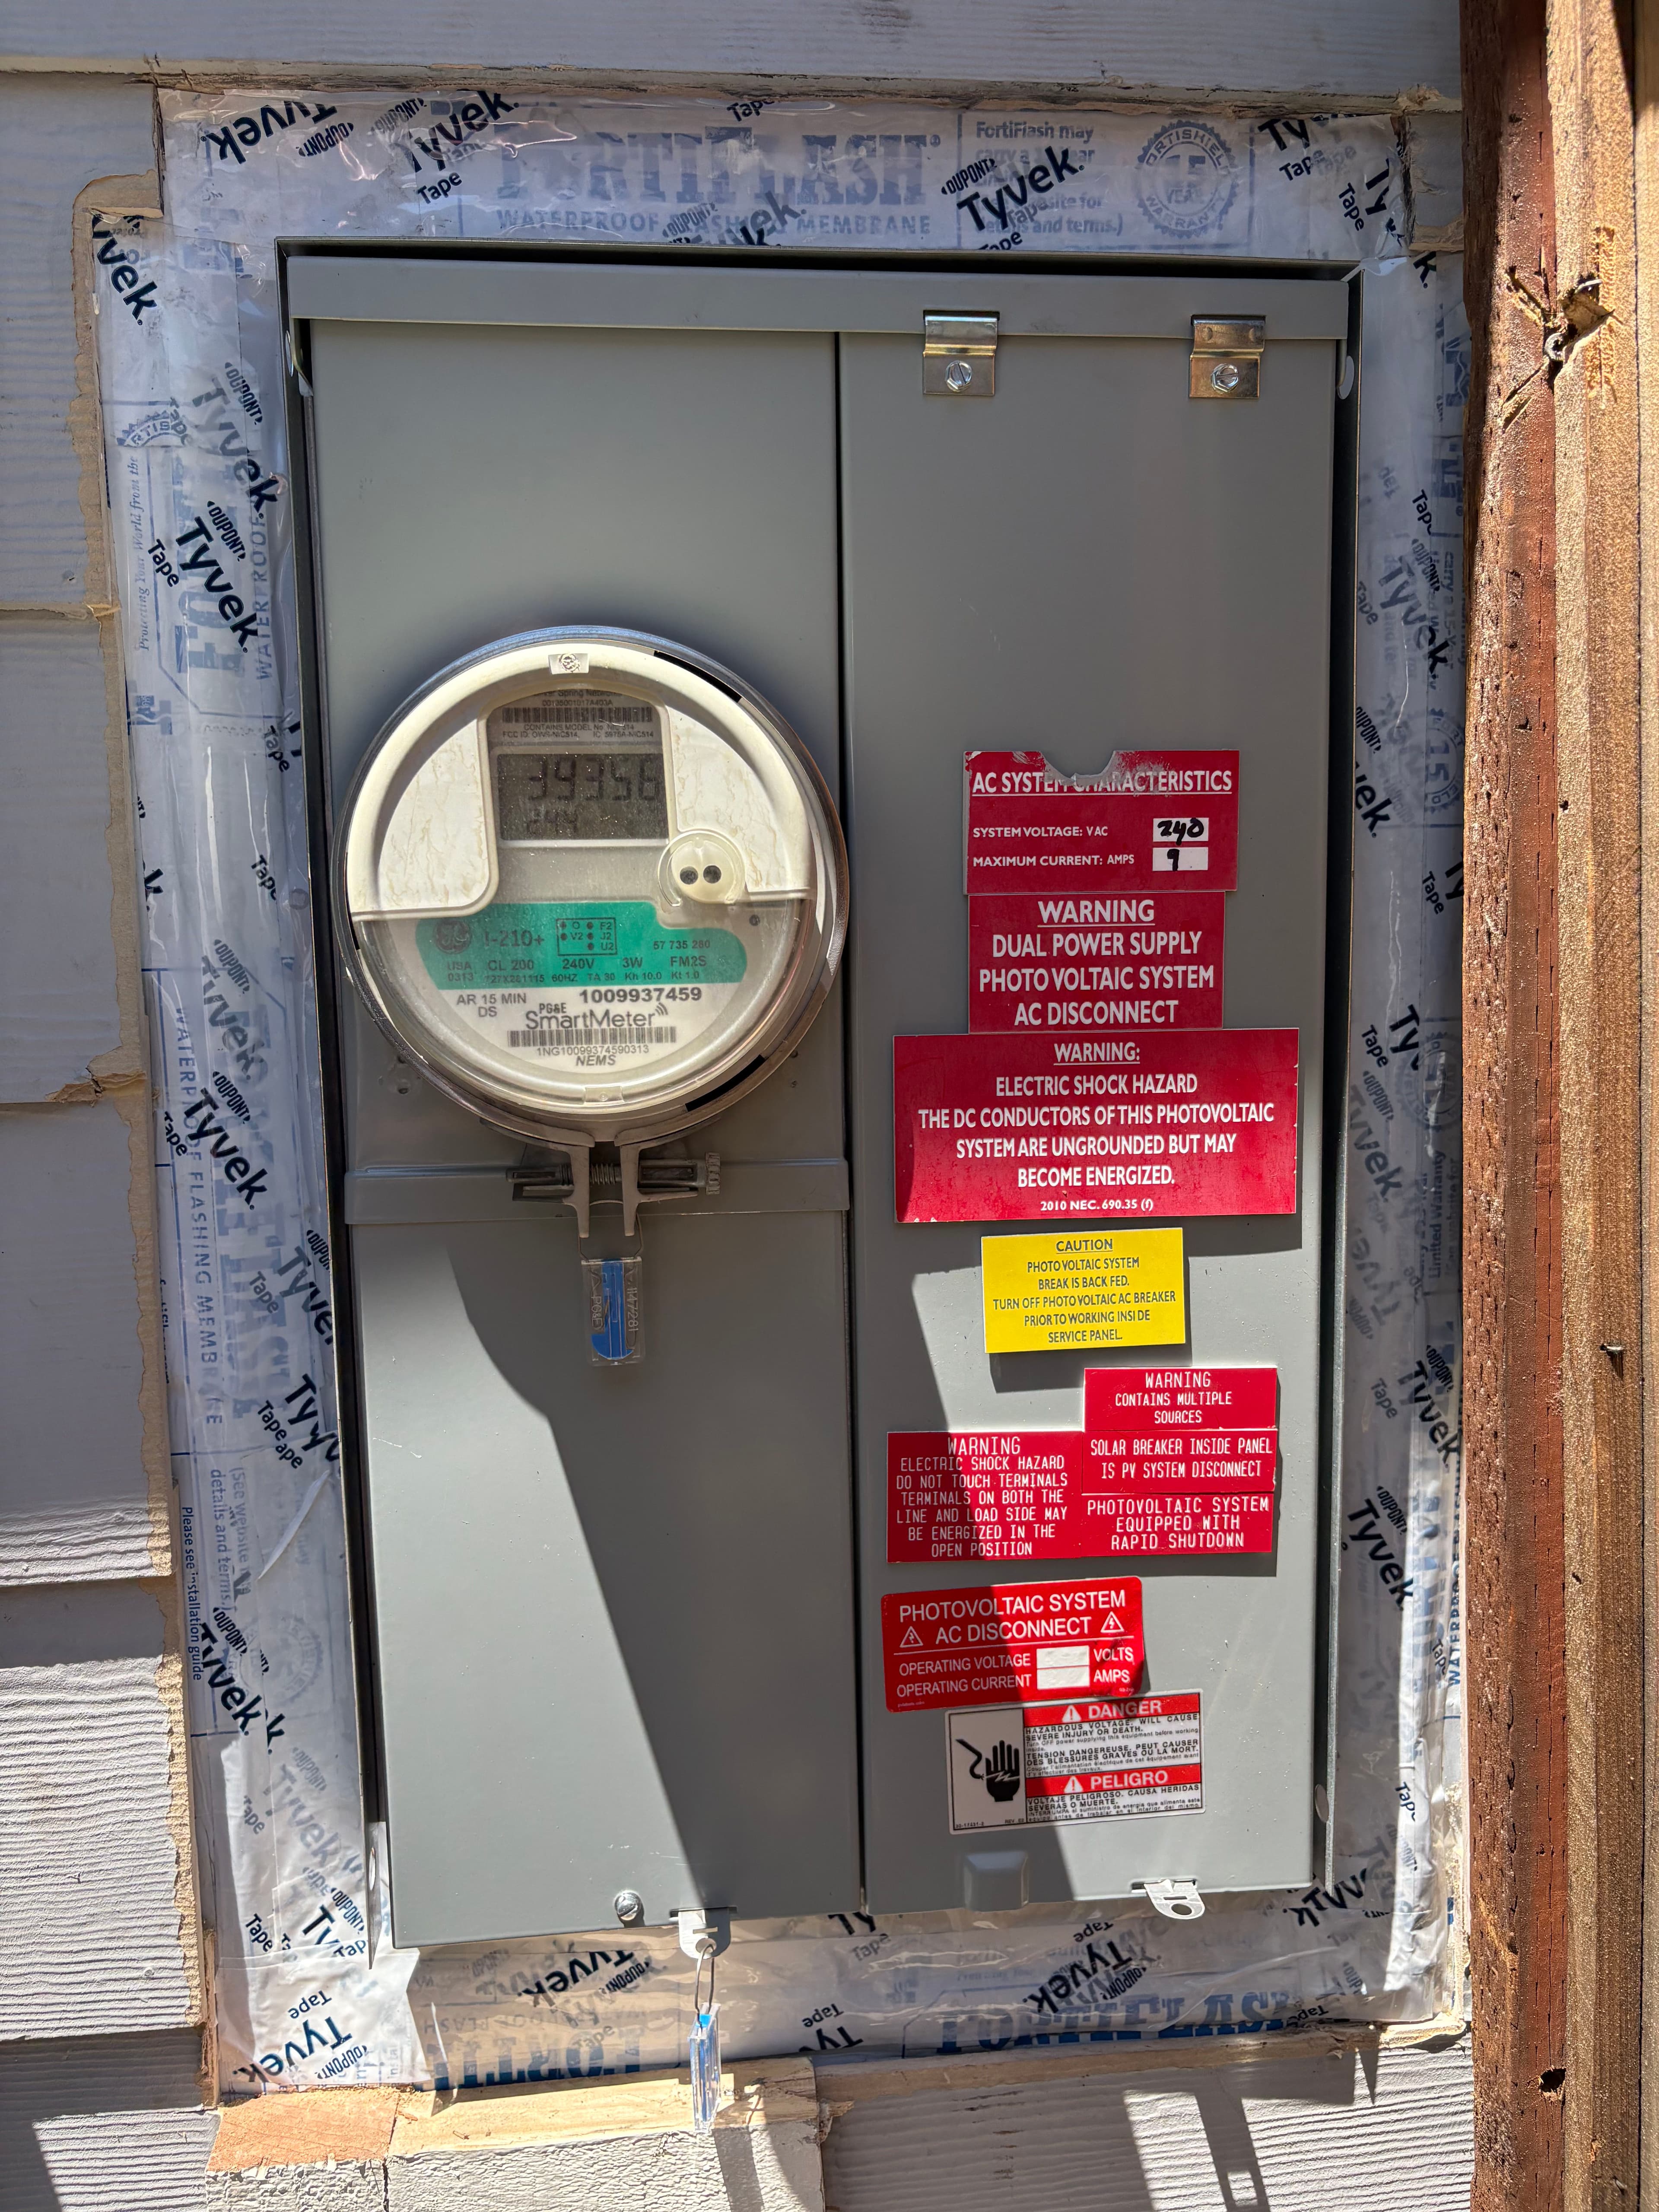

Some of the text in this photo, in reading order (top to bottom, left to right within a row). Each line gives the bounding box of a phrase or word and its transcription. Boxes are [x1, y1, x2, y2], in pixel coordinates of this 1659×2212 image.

[977, 121, 1094, 143] FortiFlash may
[417, 172, 462, 204] Tape
[1339, 183, 1364, 231] Tape
[797, 214, 930, 235] MEMBRANE
[148, 539, 179, 587] Tape
[973, 827, 1021, 837] SYSTEM
[1023, 826, 1082, 837] VOLTAGE:
[1158, 818, 1205, 845] 240
[973, 854, 1134, 867] MAXIMUM CURRENT: AMPS
[1038, 899, 1154, 923] WARNING
[669, 941, 688, 949] 735
[993, 931, 1202, 957] DUAL POWER SUPPLY
[488, 956, 706, 970] CL 200 240V 3W FM2S
[1140, 965, 1214, 989] SYSTEM
[483, 995, 496, 1004] 15
[502, 993, 526, 1003] MIN
[579, 987, 702, 1003] 1009937459
[479, 1007, 497, 1017] DS
[539, 1003, 566, 1014] PG&E
[1014, 1000, 1179, 1025] AC DISCONNECT
[526, 1010, 655, 1029] SmartMeter
[537, 1045, 649, 1056] 1NG10099374590313
[1054, 1042, 1140, 1062] WARNING:
[1361, 1024, 1389, 1067] Tape
[576, 1055, 616, 1066] NEMS
[996, 1074, 1197, 1096] ELECTRIC SHOCK HAZARD
[918, 1103, 1274, 1128] THE DC CONDUCTORS OF THIS PHOTOVOLTAIC
[164, 1111, 188, 1157] Tape
[957, 1134, 1236, 1158] SYSTEM ARE UNGROUNDED BUT MAY
[1018, 1165, 1175, 1187] BECOME ENERGIZED.
[1041, 1199, 1153, 1211] 2010 NEC. 690.35 (f)
[1056, 1239, 1112, 1252] CAUTION
[1104, 1257, 1139, 1269] SYSTEM
[1039, 1275, 1129, 1290] BREAK IS BACK FED.
[993, 1298, 1019, 1309] TURN
[1023, 1297, 1039, 1308] OFF
[1118, 1293, 1131, 1304] AC
[1134, 1291, 1176, 1303] BREAKER
[1025, 1315, 1052, 1326] PRIOR
[1053, 1314, 1066, 1325] TO
[1068, 1312, 1114, 1324] WORKING
[1049, 1329, 1122, 1343] SERVICE PANEL.
[1146, 1372, 1211, 1388] WARNING
[1116, 1392, 1231, 1406] CONTAINS MULTIPLE
[1154, 1410, 1201, 1424] SOURCES
[948, 1437, 1020, 1455] WARNING
[901, 1455, 1064, 1471] ELECTRIC SHOCK HAZARD
[896, 1472, 1067, 1489] DO NOT TOUCH TERMINALS
[901, 1489, 1063, 1506] TERMINALS ON BOTH THE
[897, 1506, 1067, 1523] LINE AND LOAD SIDE MAY
[182, 1507, 194, 1545] Please
[909, 1524, 1055, 1541] BE ENERGIZED IN THE
[931, 1541, 1032, 1557] OPEN POSITION
[185, 1549, 194, 1569] see
[900, 1590, 1125, 1622] PHOTOVOLTAIC SYSTEM
[936, 1617, 1091, 1644] AC DISCONNECT
[188, 1646, 203, 1680] guide
[1094, 1647, 1133, 1662] VOLTS
[899, 1653, 1030, 1676] OPERATING VOLTAGE
[1093, 1669, 1130, 1683] AMPS
[897, 1674, 1031, 1697] OPERATING CURRENT
[1089, 1701, 1161, 1717] DANGER
[1026, 1724, 1083, 1734] HAZARDOUS
[1089, 1719, 1133, 1729] VOLTAGE.
[1167, 1714, 1198, 1722] CAUSE
[1026, 1732, 1059, 1741] SEVERE
[1062, 1730, 1093, 1738] INJURY
[1027, 1750, 1065, 1759] TENSION
[1070, 1745, 1131, 1755] DANGEREUSE.
[1163, 1740, 1198, 1748] CAUSER
[1091, 1771, 1168, 1789] PELIGRO
[246, 1913, 273, 1952] Tape
[1073, 1922, 1113, 1943] Tape
[288, 1990, 332, 2019] Tape
